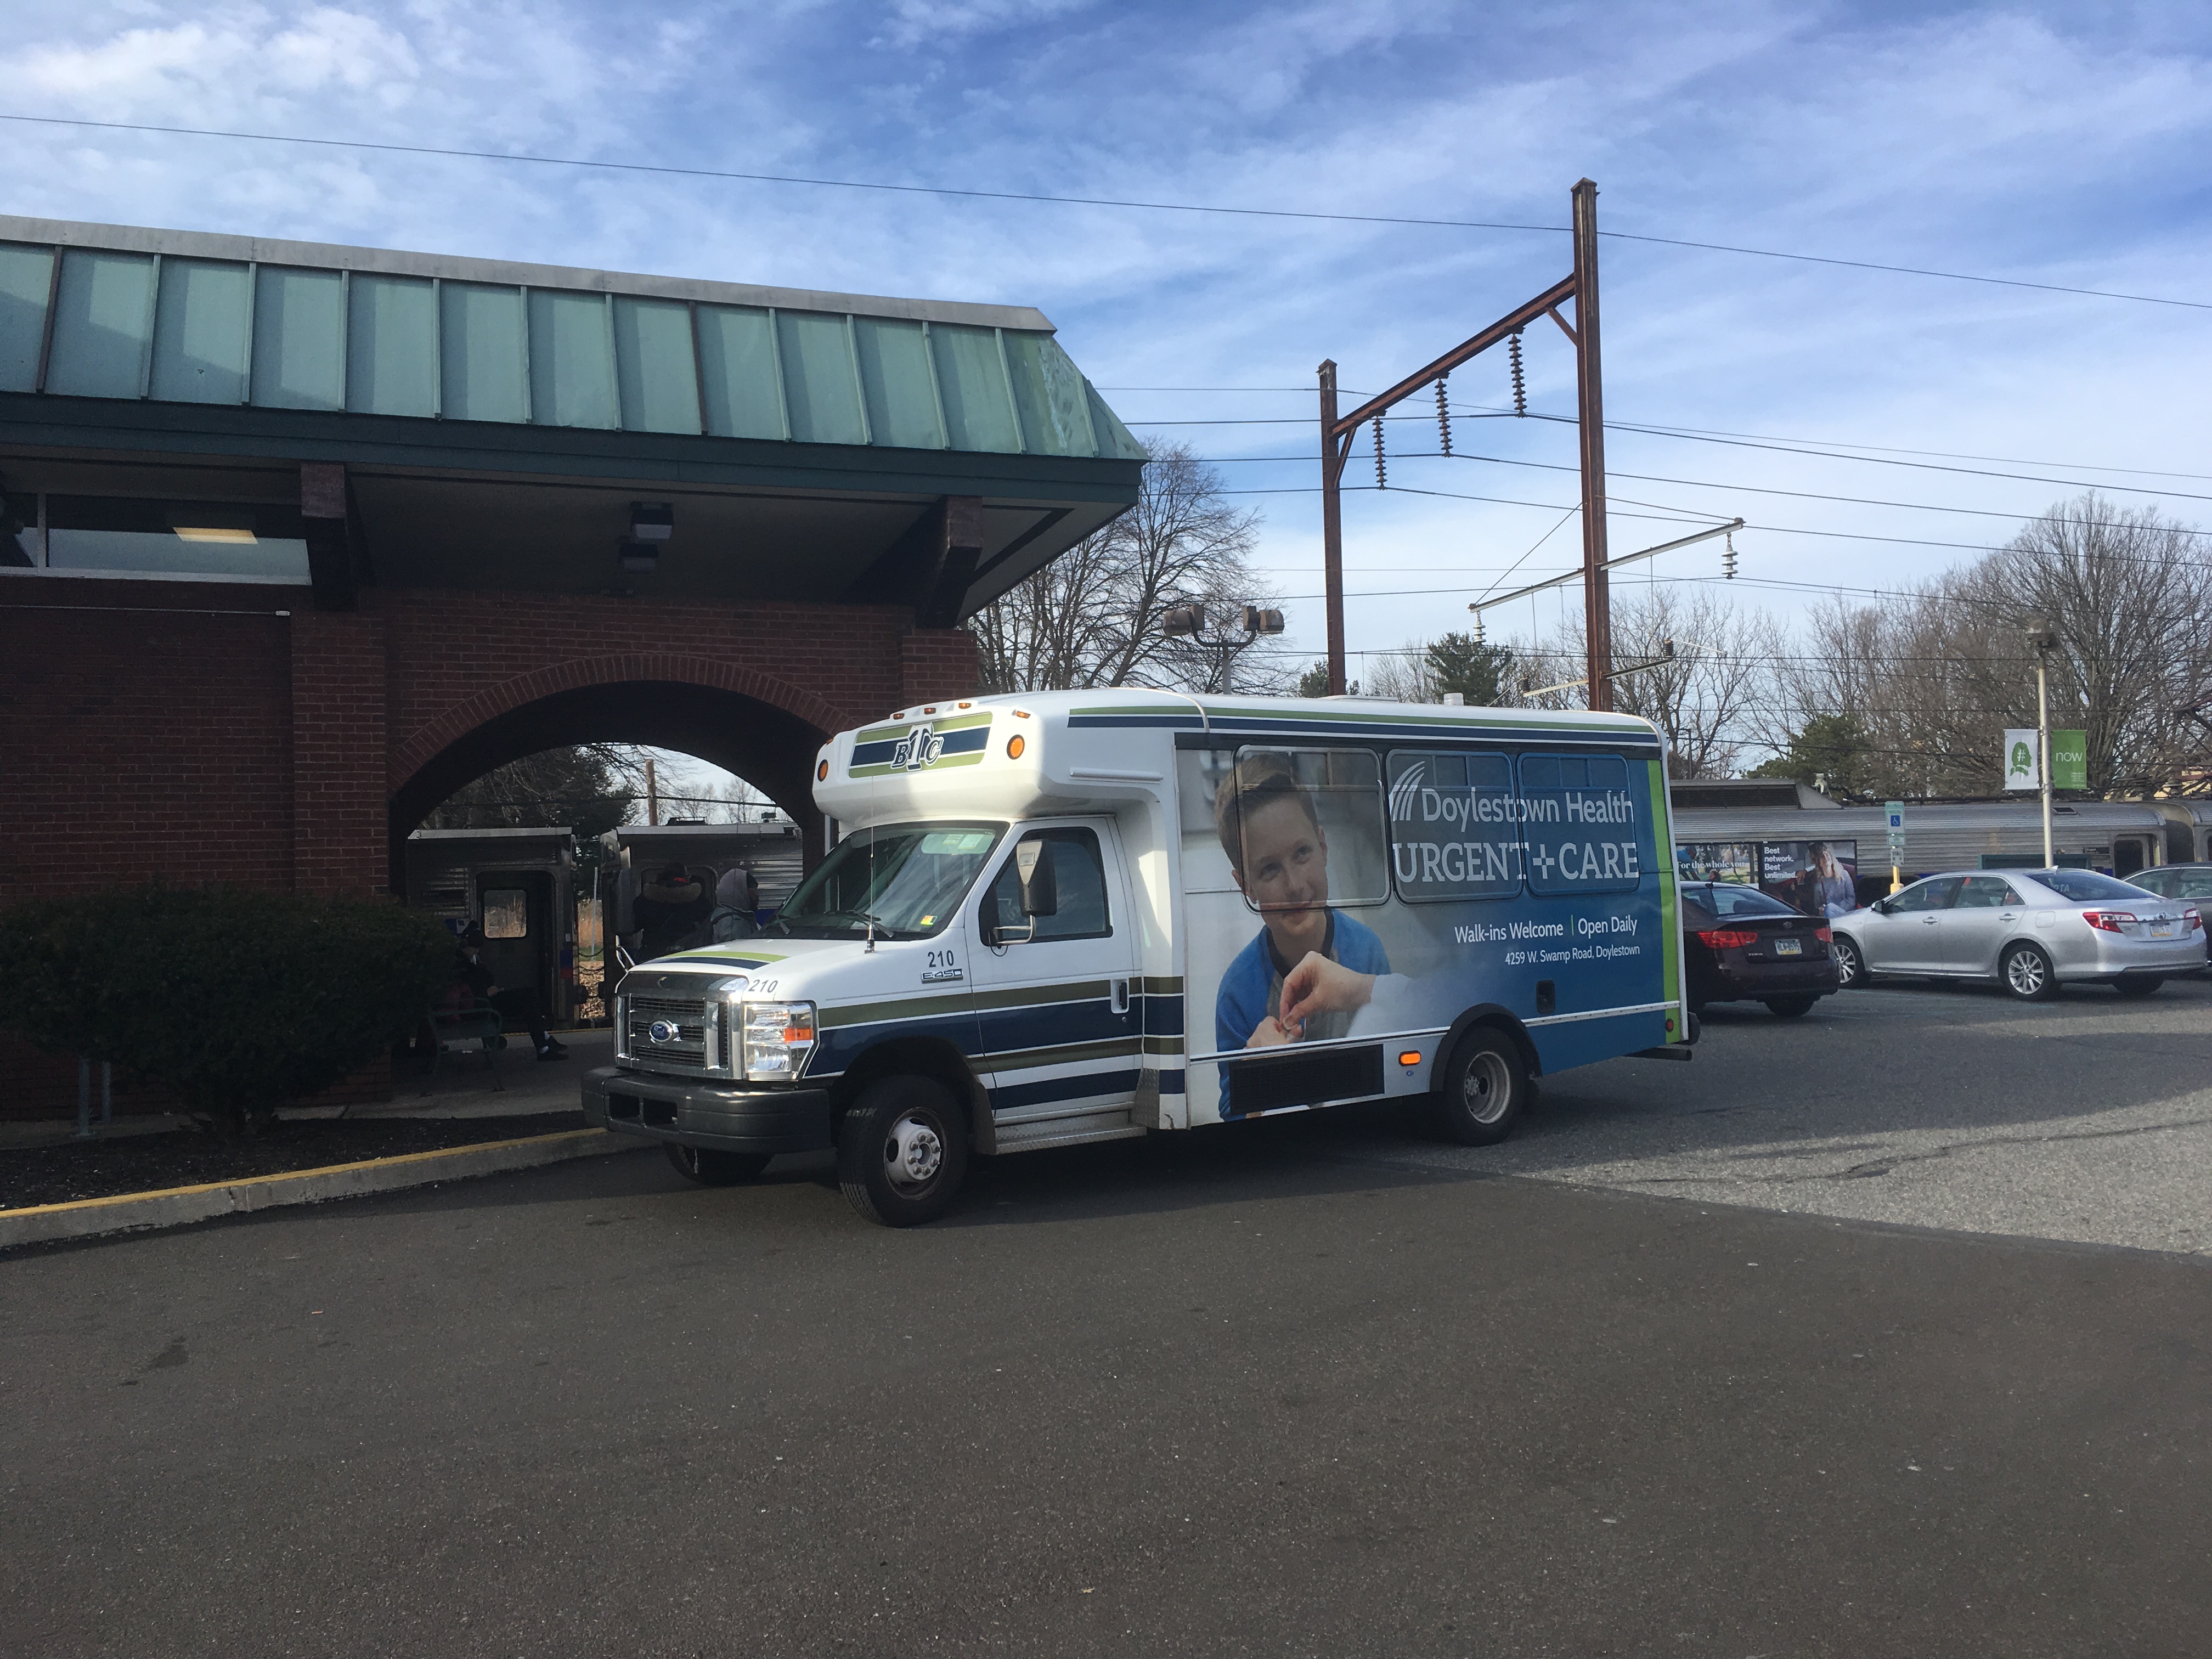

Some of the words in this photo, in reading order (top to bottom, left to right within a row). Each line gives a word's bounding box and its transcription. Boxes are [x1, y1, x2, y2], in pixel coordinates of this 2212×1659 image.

[890, 723, 944, 771] BTC
[2056, 752, 2083, 761] now
[1422, 787, 1560, 832] Doylestown
[1566, 790, 1634, 823] Health
[1691, 860, 1705, 868] the
[1706, 860, 1730, 868] whole
[1454, 924, 1506, 943] Walk-ins
[1509, 921, 1564, 939] Welcome
[1578, 918, 1608, 939] Open
[1611, 915, 1638, 936] Daily
[928, 950, 954, 968] 210
[1505, 951, 1525, 965] 4259
[1527, 951, 1538, 963] W.
[1540, 949, 1570, 964] Swamp
[1572, 946, 1594, 960] Road,
[1596, 945, 1640, 960] Doylestown
[748, 979, 778, 993] 210
